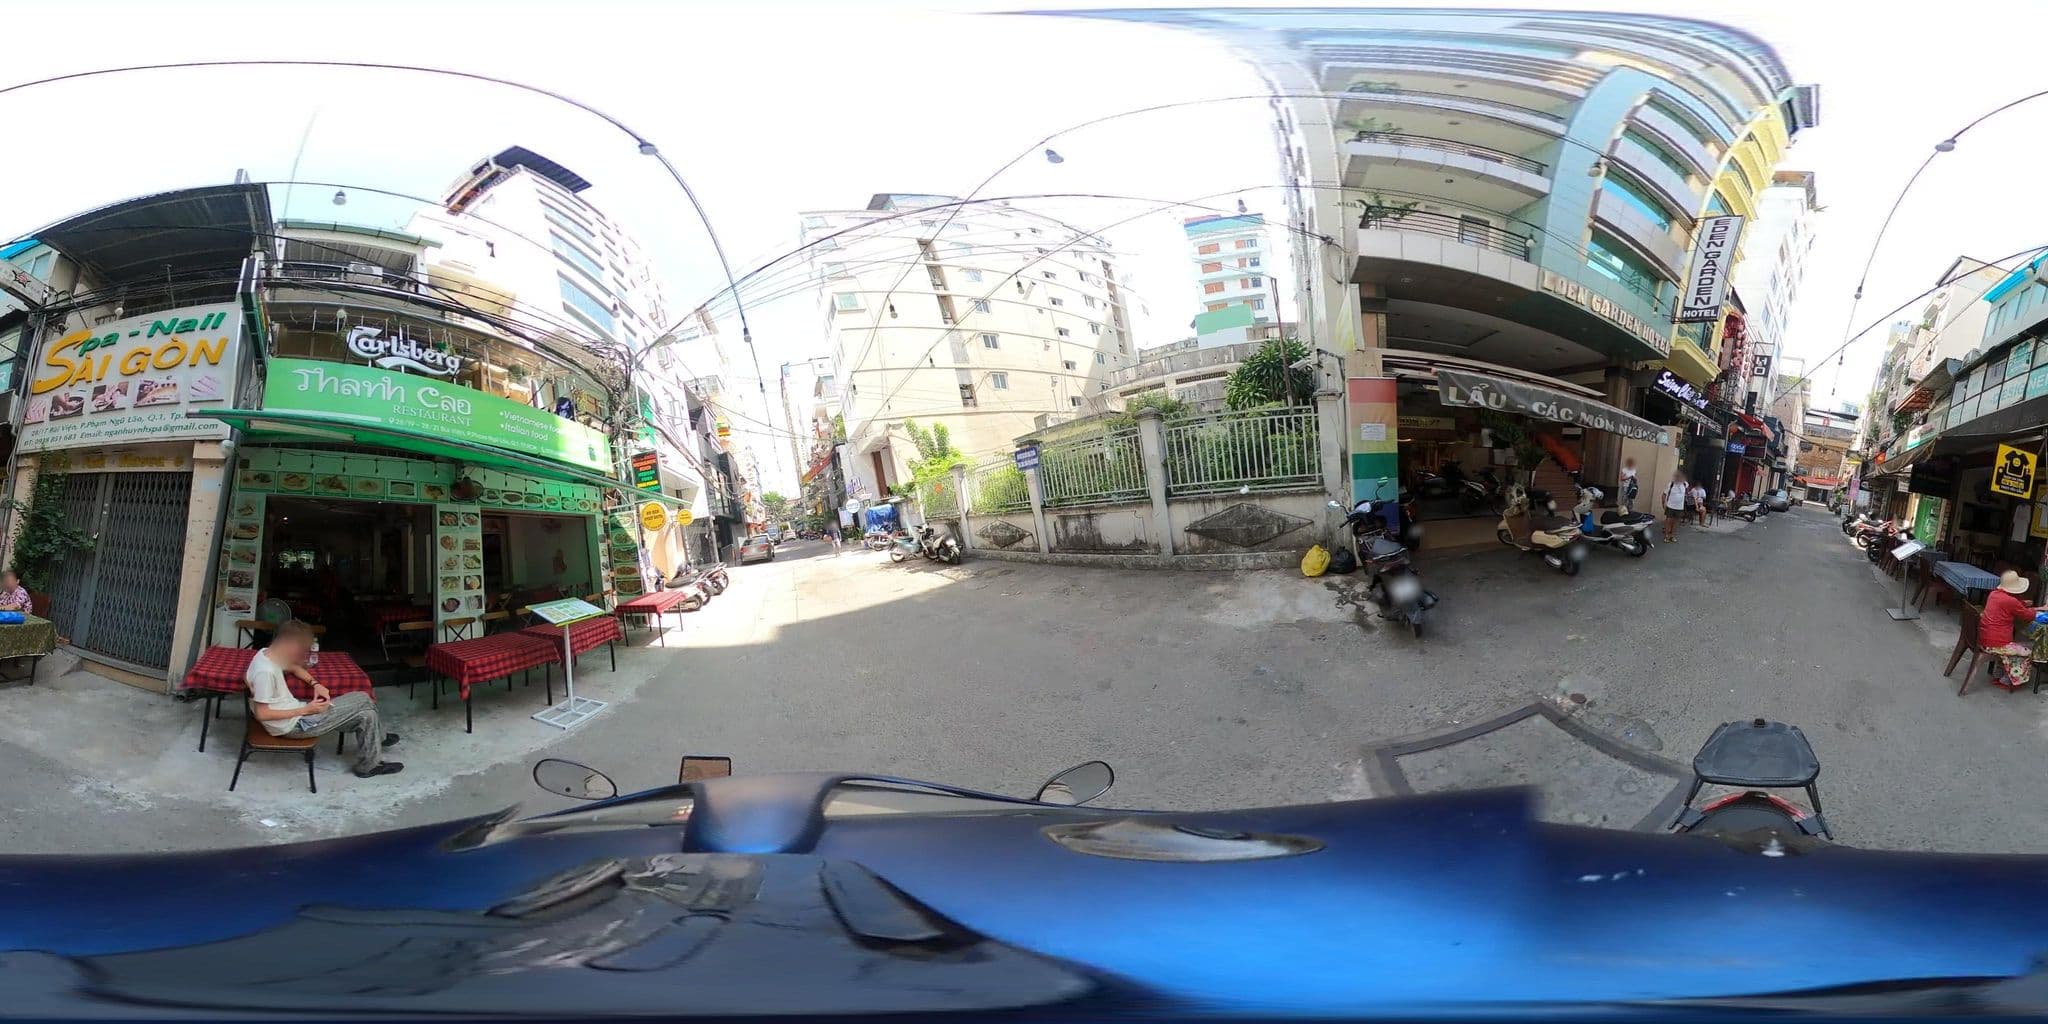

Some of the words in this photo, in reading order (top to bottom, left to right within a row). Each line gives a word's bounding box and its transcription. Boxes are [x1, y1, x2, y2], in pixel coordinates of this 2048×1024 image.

[1707, 218, 1731, 248] EDEN
[1694, 251, 1721, 306] GARDEN
[147, 312, 227, 338] Nail
[1591, 293, 1642, 336] GARDEN
[1642, 324, 1671, 355] HOTEL
[1683, 309, 1717, 318] HOTEL
[119, 336, 229, 376] GÒN
[347, 325, 460, 375] Carlsberg
[292, 367, 406, 403] Thanh
[417, 386, 472, 415] Cao
[1448, 382, 1507, 409] LẨU
[1531, 400, 1574, 421] CÁC
[393, 404, 473, 427] RESTAURANT
[503, 410, 549, 430] Vietnamese
[504, 423, 530, 437] Italian
[531, 429, 549, 441] food
